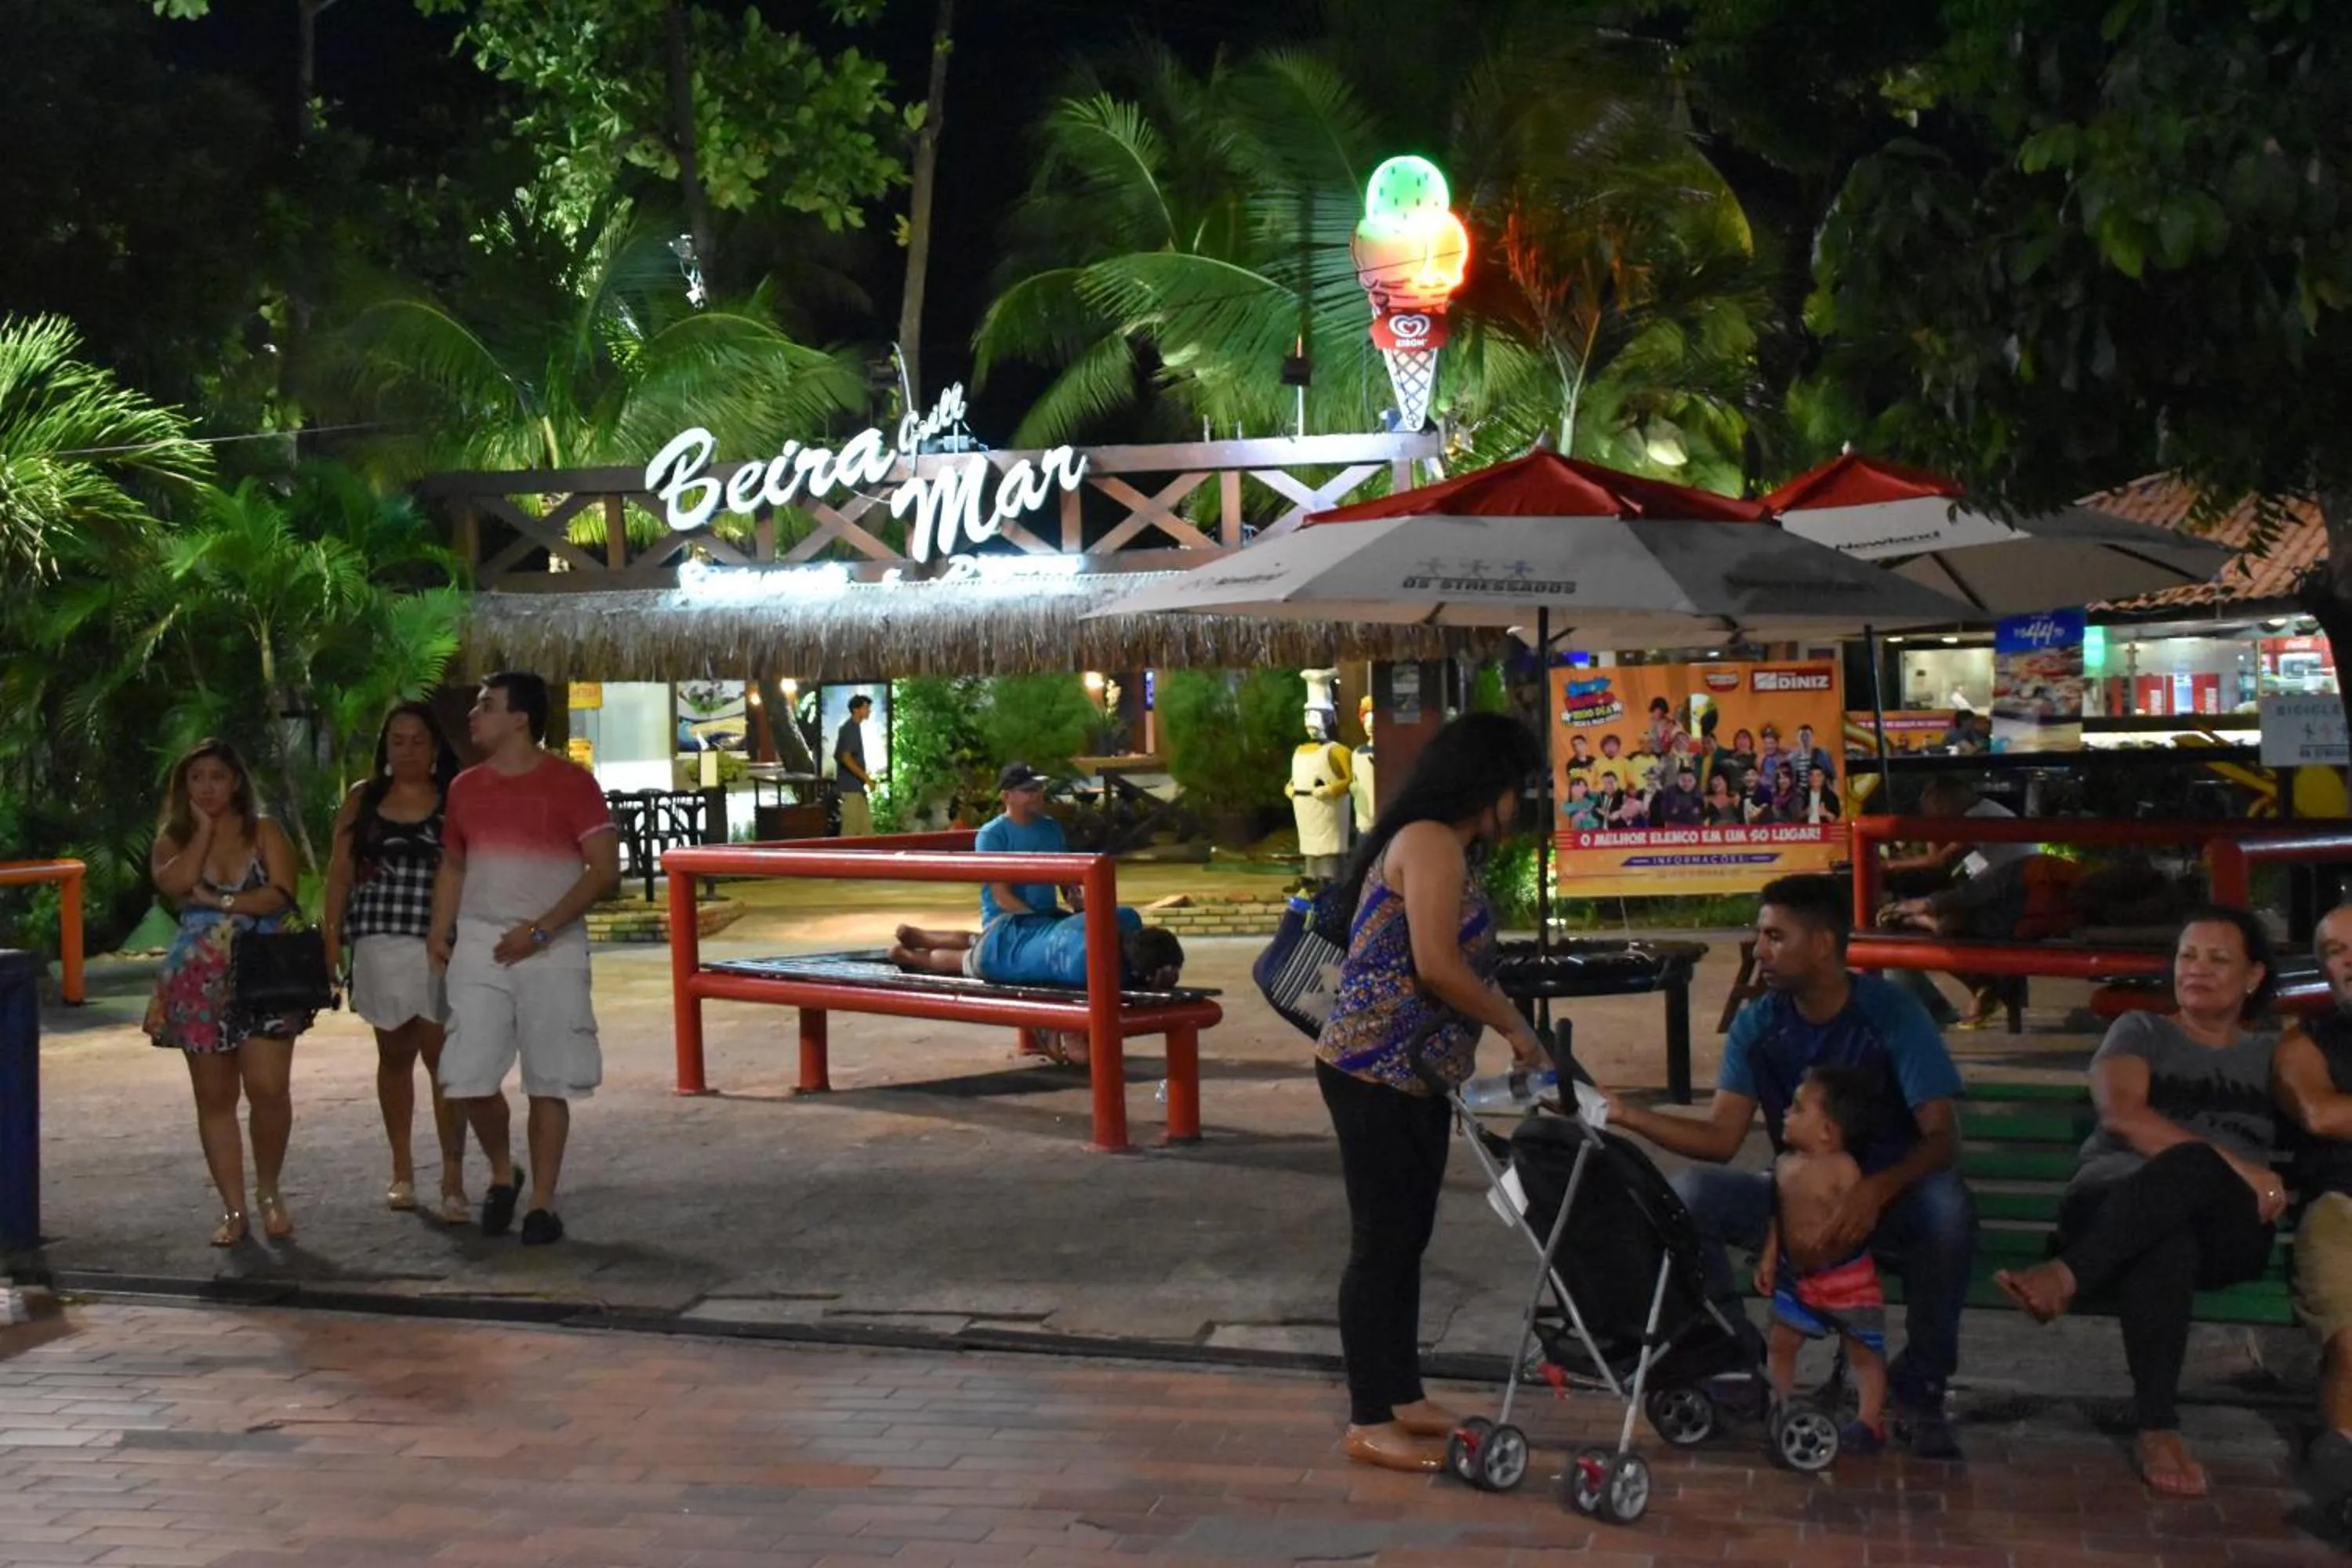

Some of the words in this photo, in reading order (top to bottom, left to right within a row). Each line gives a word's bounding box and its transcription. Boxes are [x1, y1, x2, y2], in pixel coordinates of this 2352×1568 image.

[898, 382, 967, 452] Grill
[645, 427, 896, 531] Beira
[891, 445, 1088, 563] Mar
[1778, 675, 1829, 690] DINIZ
[1580, 833, 1591, 847] O
[1594, 832, 1647, 847] MELHOR
[1649, 830, 1699, 844] ELENCO
[1701, 829, 1722, 843] EM
